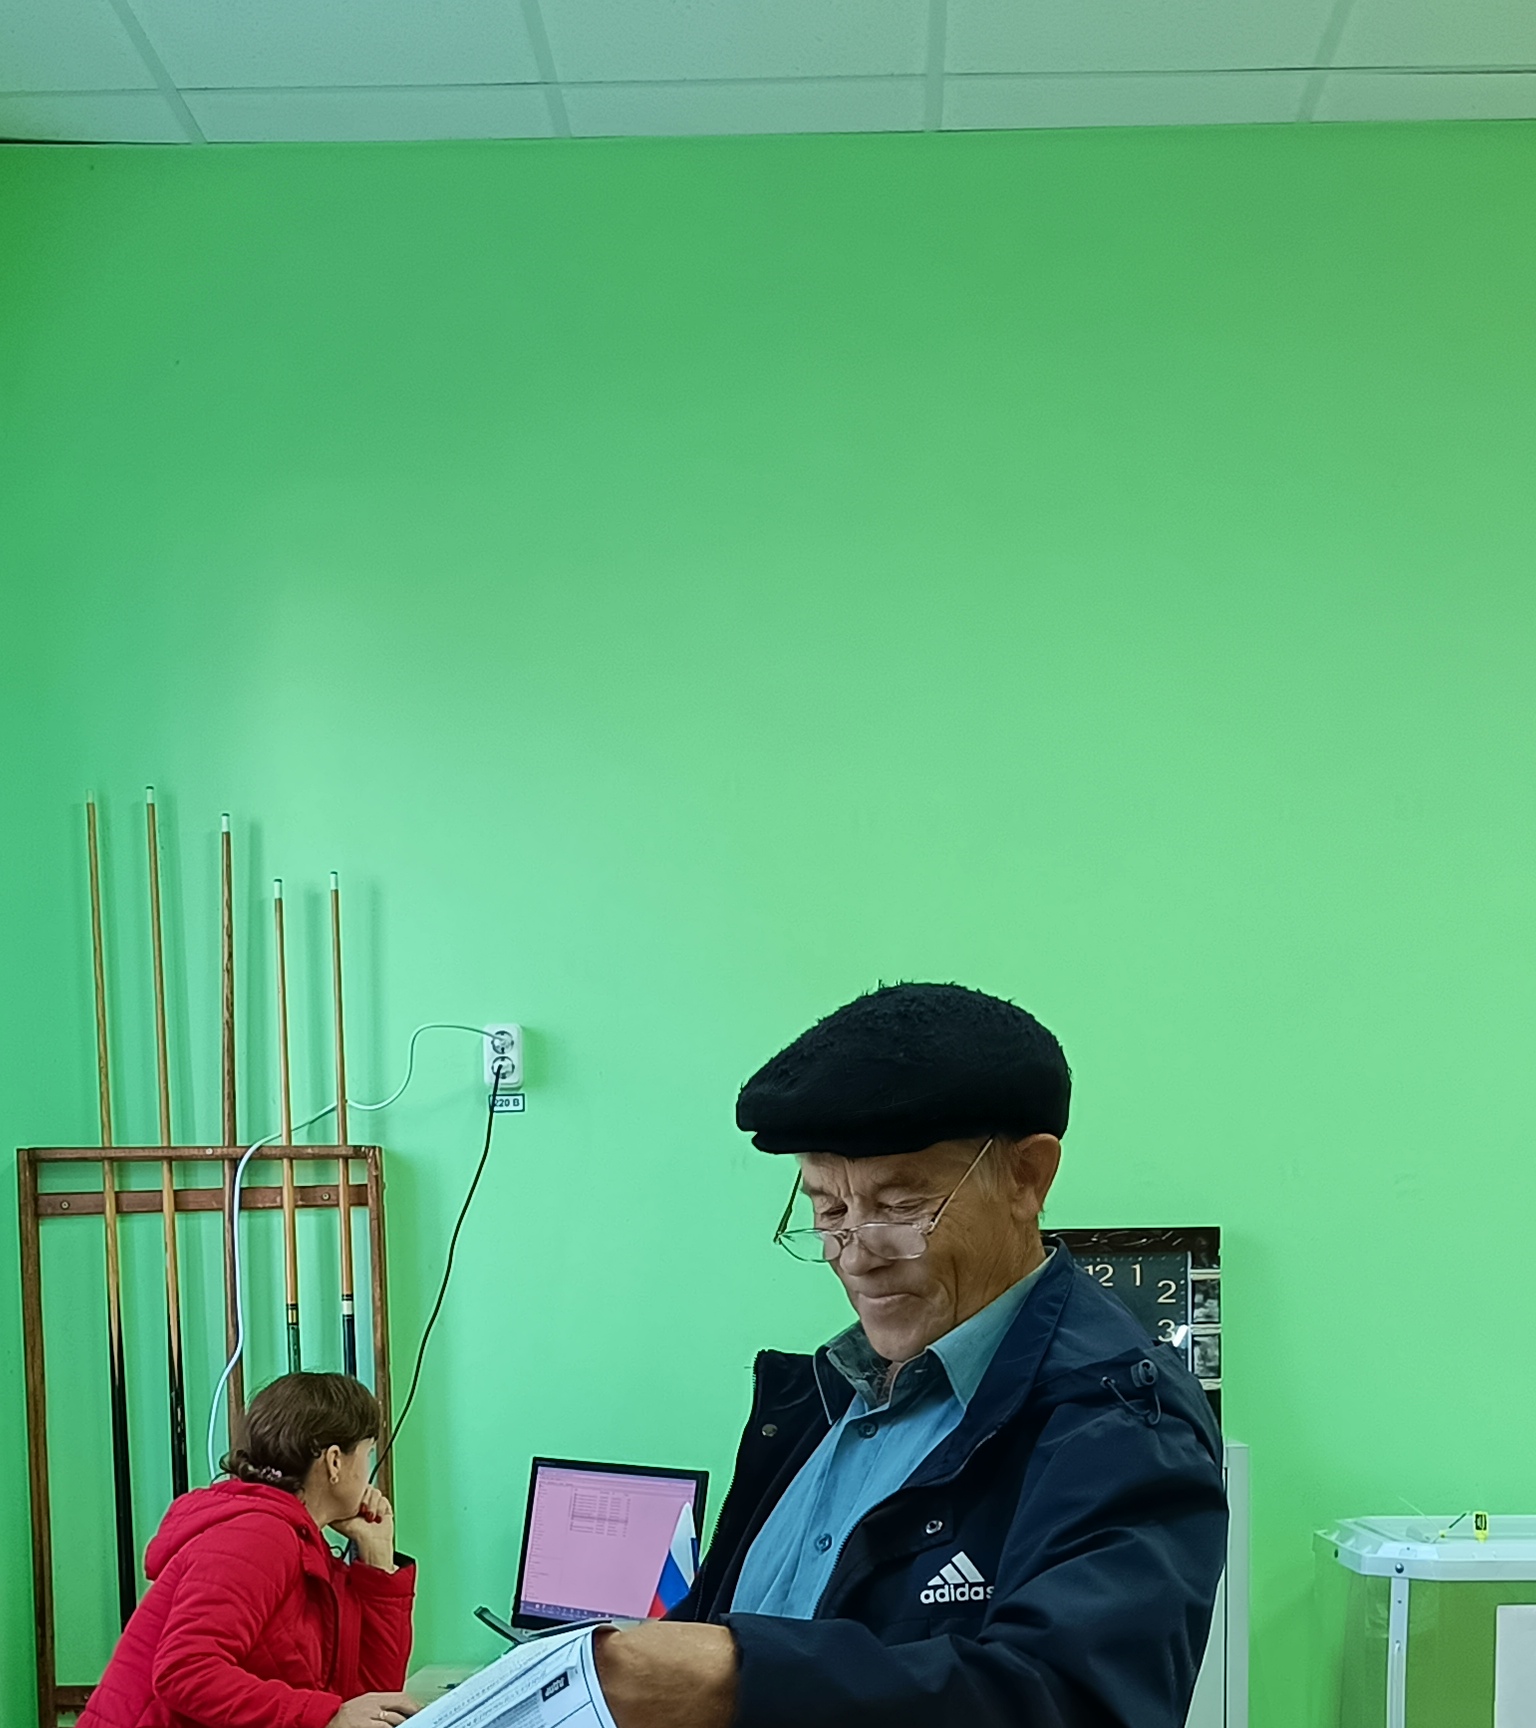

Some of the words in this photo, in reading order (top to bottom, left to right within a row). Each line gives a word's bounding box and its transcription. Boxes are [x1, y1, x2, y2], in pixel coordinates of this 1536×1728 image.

[1085, 1264, 1114, 1286] 12
[1132, 1264, 1141, 1286] 1
[1157, 1280, 1176, 1303] 2
[1158, 1319, 1176, 1342] 3
